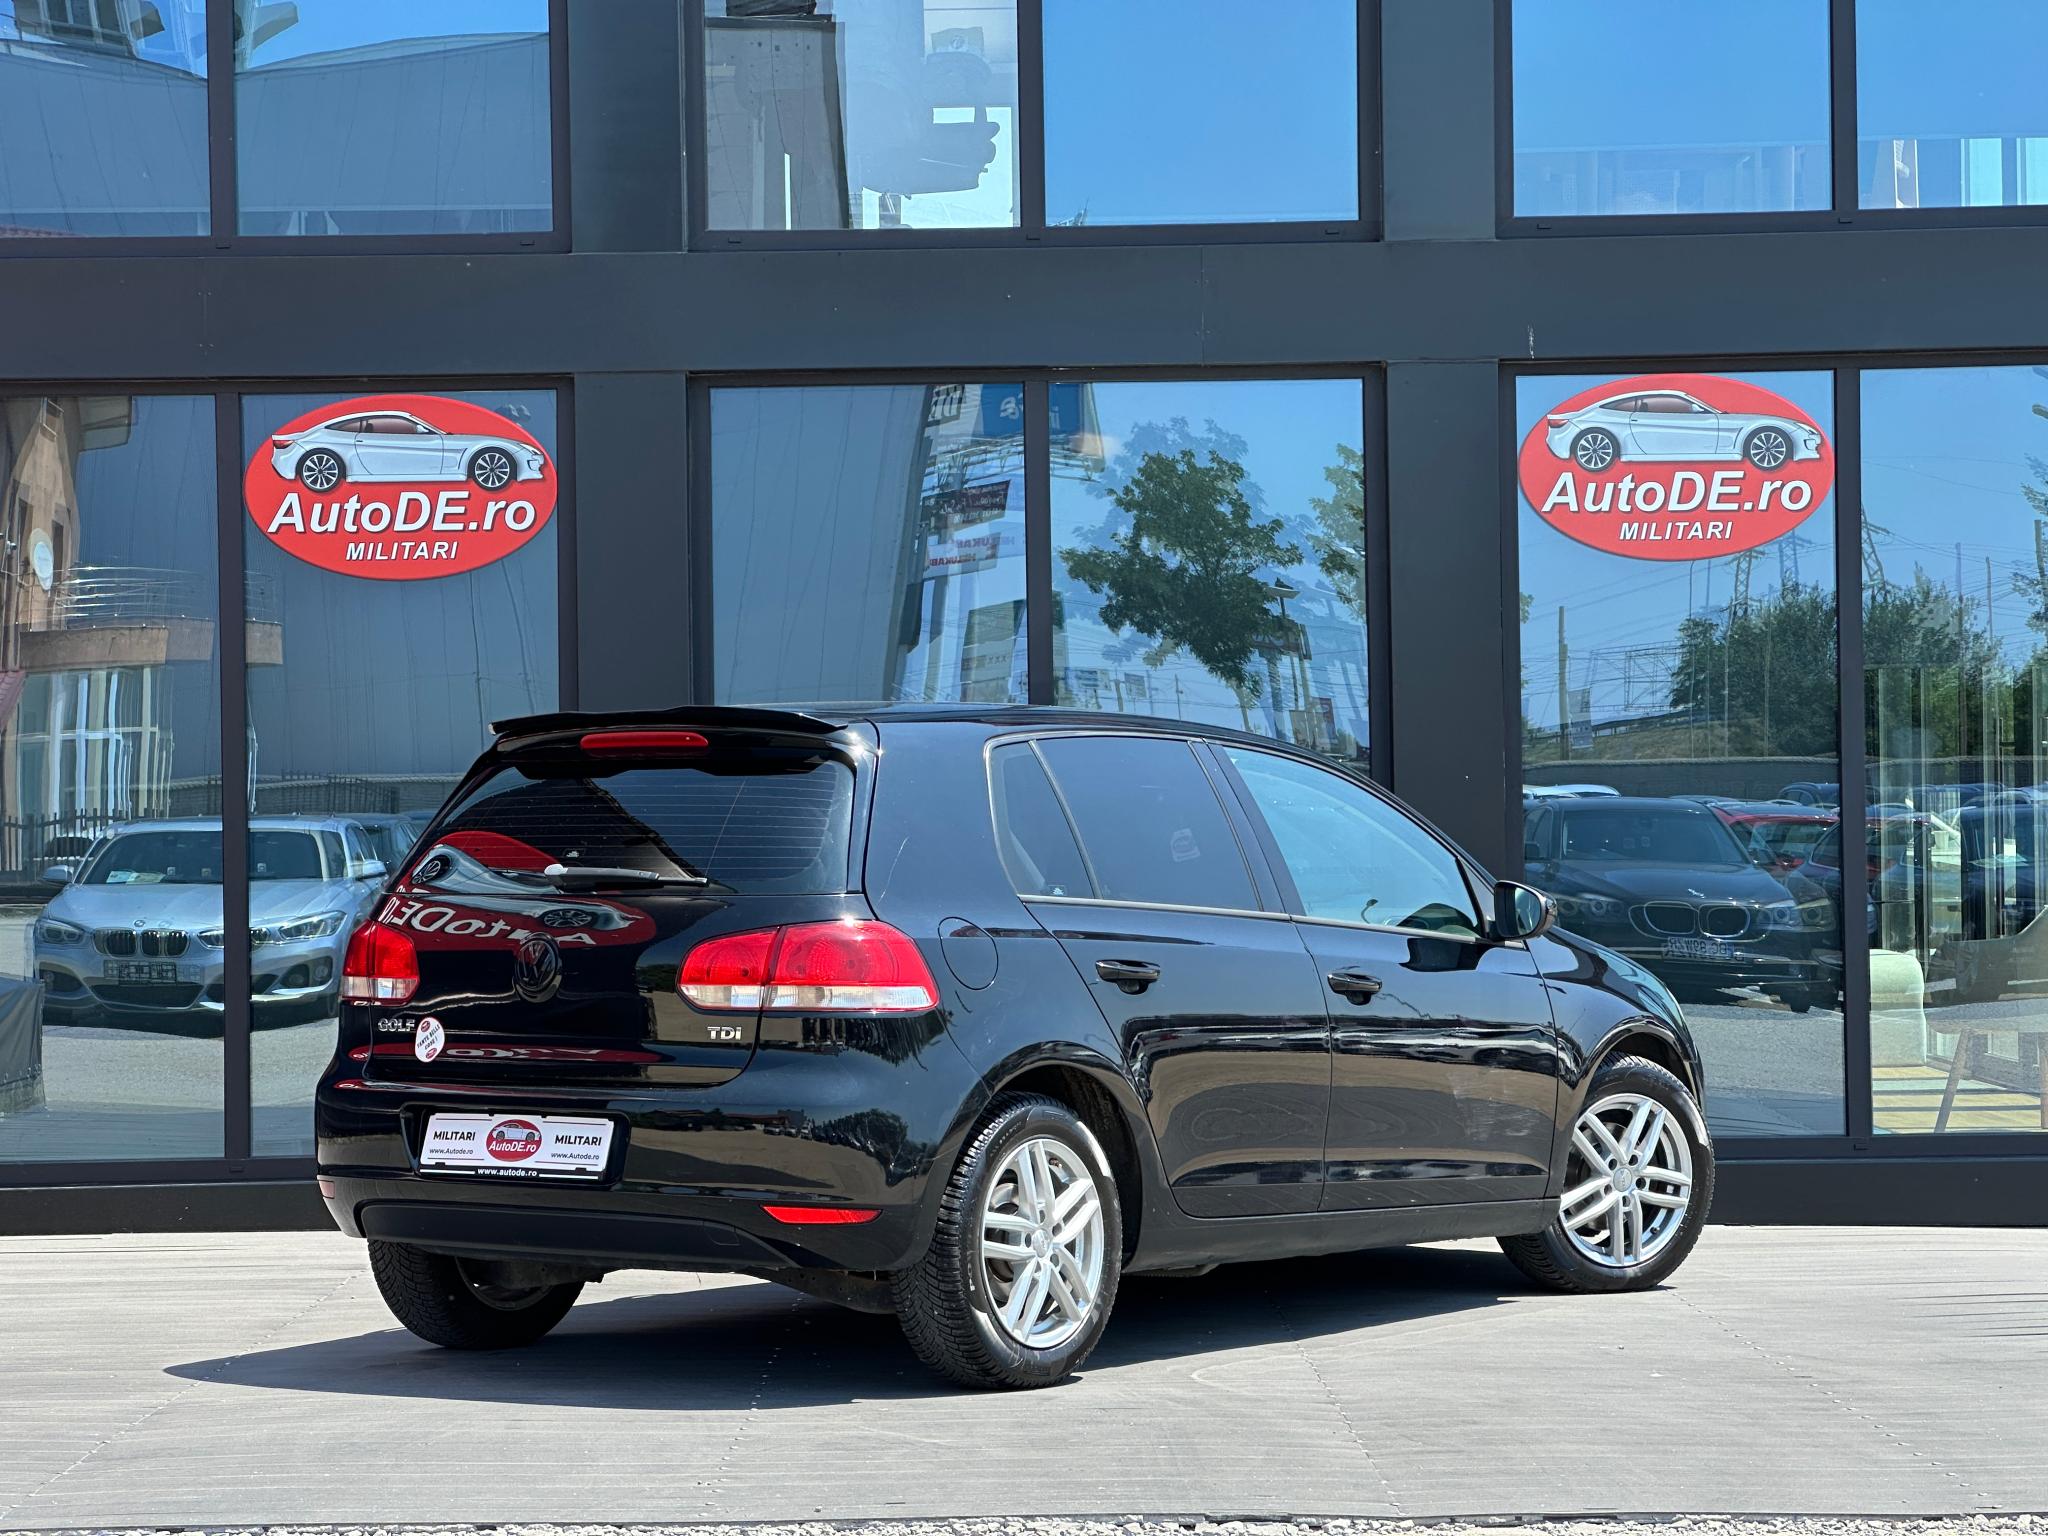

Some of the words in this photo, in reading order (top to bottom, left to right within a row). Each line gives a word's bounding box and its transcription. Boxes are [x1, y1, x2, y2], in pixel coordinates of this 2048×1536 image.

[1541, 471, 1813, 513] AutoDE.ro
[267, 491, 537, 533] AutoDE.ro
[1619, 521, 1733, 541] MILITARI
[345, 541, 459, 561] MILITARI
[377, 1018, 416, 1032] GOLF
[433, 1131, 476, 1141] MILITARI
[554, 1134, 602, 1146] MILITARI
[429, 1147, 474, 1155] www.Autode.ro
[489, 1140, 537, 1153] AutoDE.ro
[551, 1151, 600, 1160] www.Autode.ro
[477, 1168, 538, 1177] www.autode.ro
